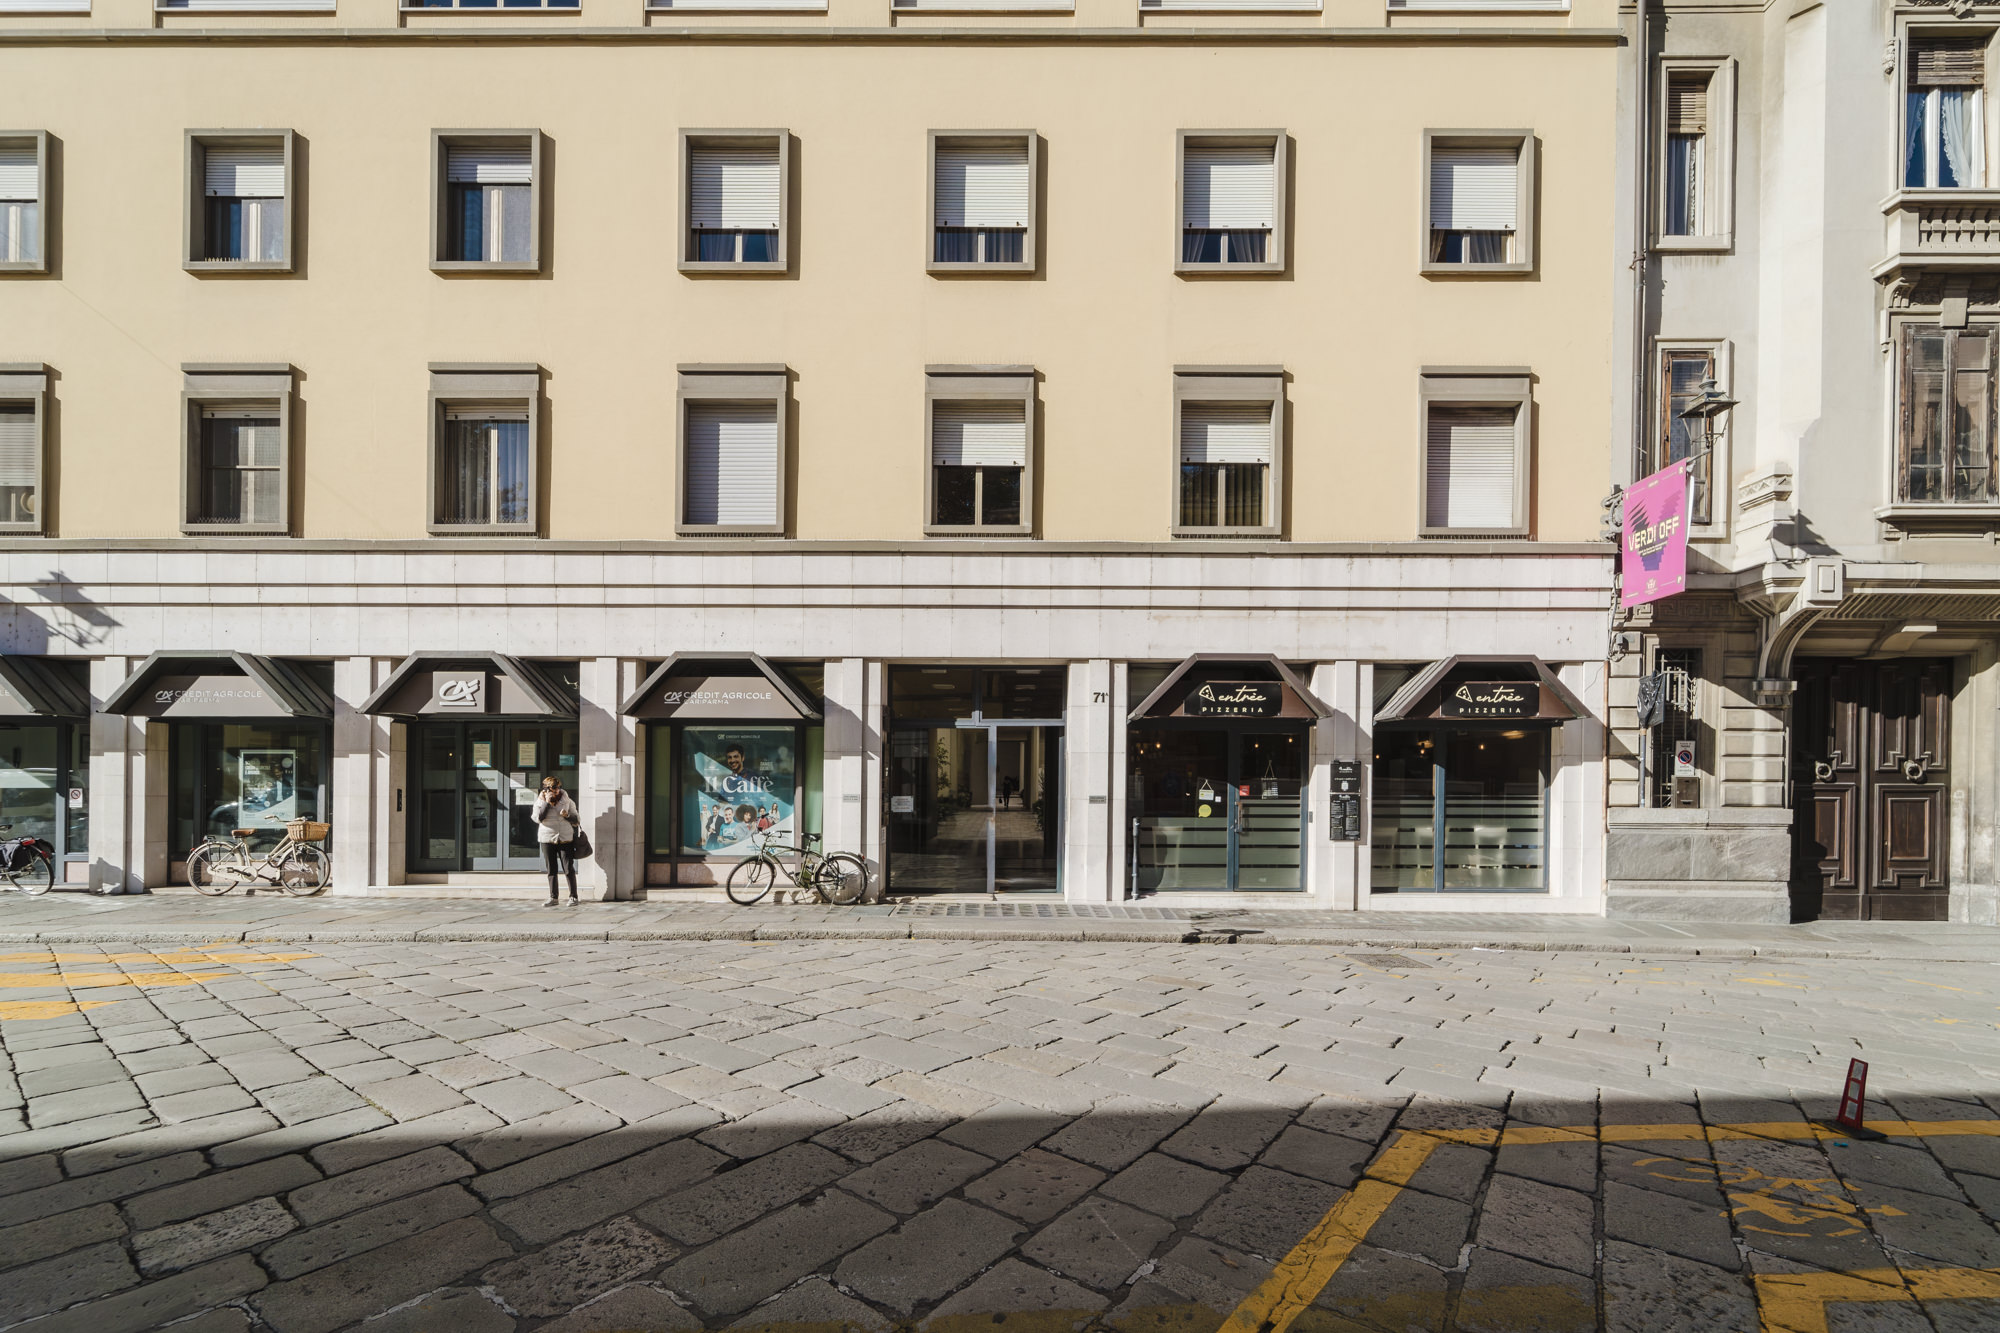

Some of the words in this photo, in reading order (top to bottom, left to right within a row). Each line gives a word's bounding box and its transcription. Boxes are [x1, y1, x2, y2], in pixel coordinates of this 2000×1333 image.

[1628, 524, 1657, 551] VERDI
[1659, 516, 1679, 539] OFF
[213, 690, 262, 698] AGRICOLE
[722, 692, 772, 700] AGRICOLE
[704, 776, 719, 793] Il
[722, 775, 775, 793] Caffè
